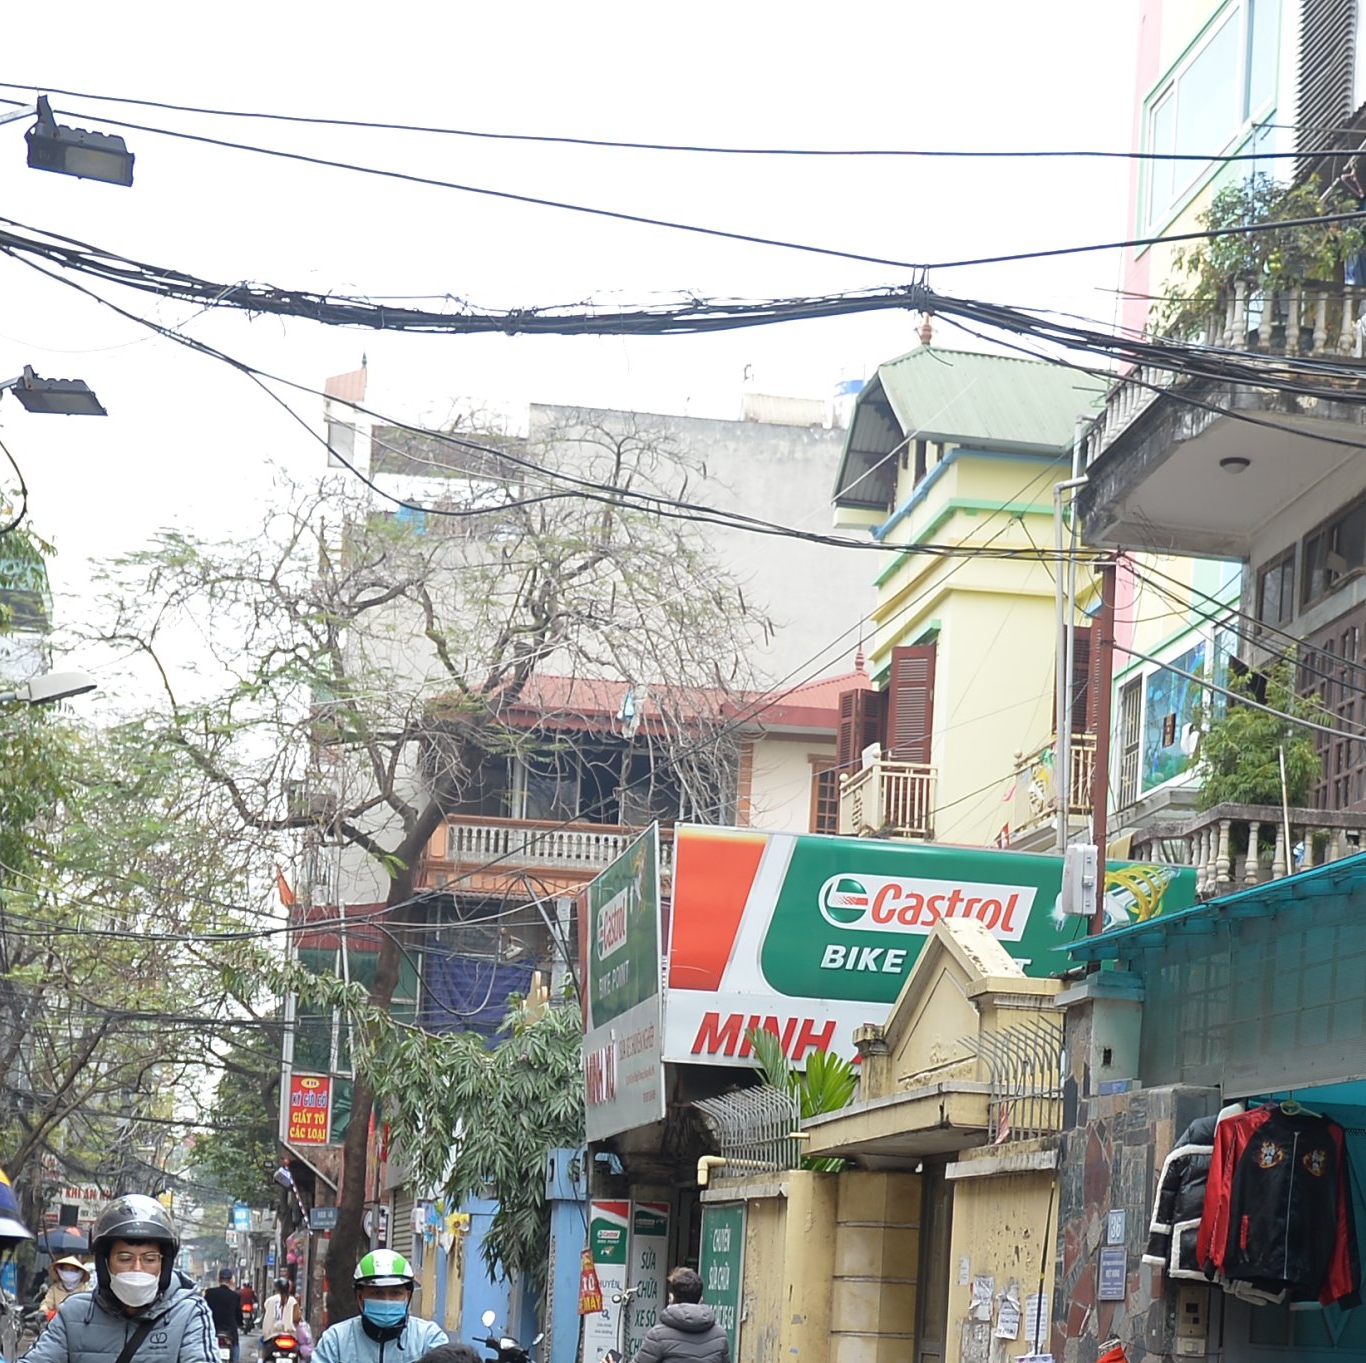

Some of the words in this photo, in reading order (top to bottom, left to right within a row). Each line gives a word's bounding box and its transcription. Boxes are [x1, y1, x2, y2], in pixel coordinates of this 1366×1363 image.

[871, 882, 1020, 933] Castrol
[820, 945, 906, 974] BIKE
[690, 1011, 837, 1061] MINH
[292, 1109, 312, 1124] GIẤY
[314, 1111, 325, 1125] TỜ
[289, 1124, 306, 1138] CÁC
[308, 1128, 327, 1142] LOẠI
[1110, 1215, 1122, 1238] 36
[641, 1246, 657, 1270] SỬA
